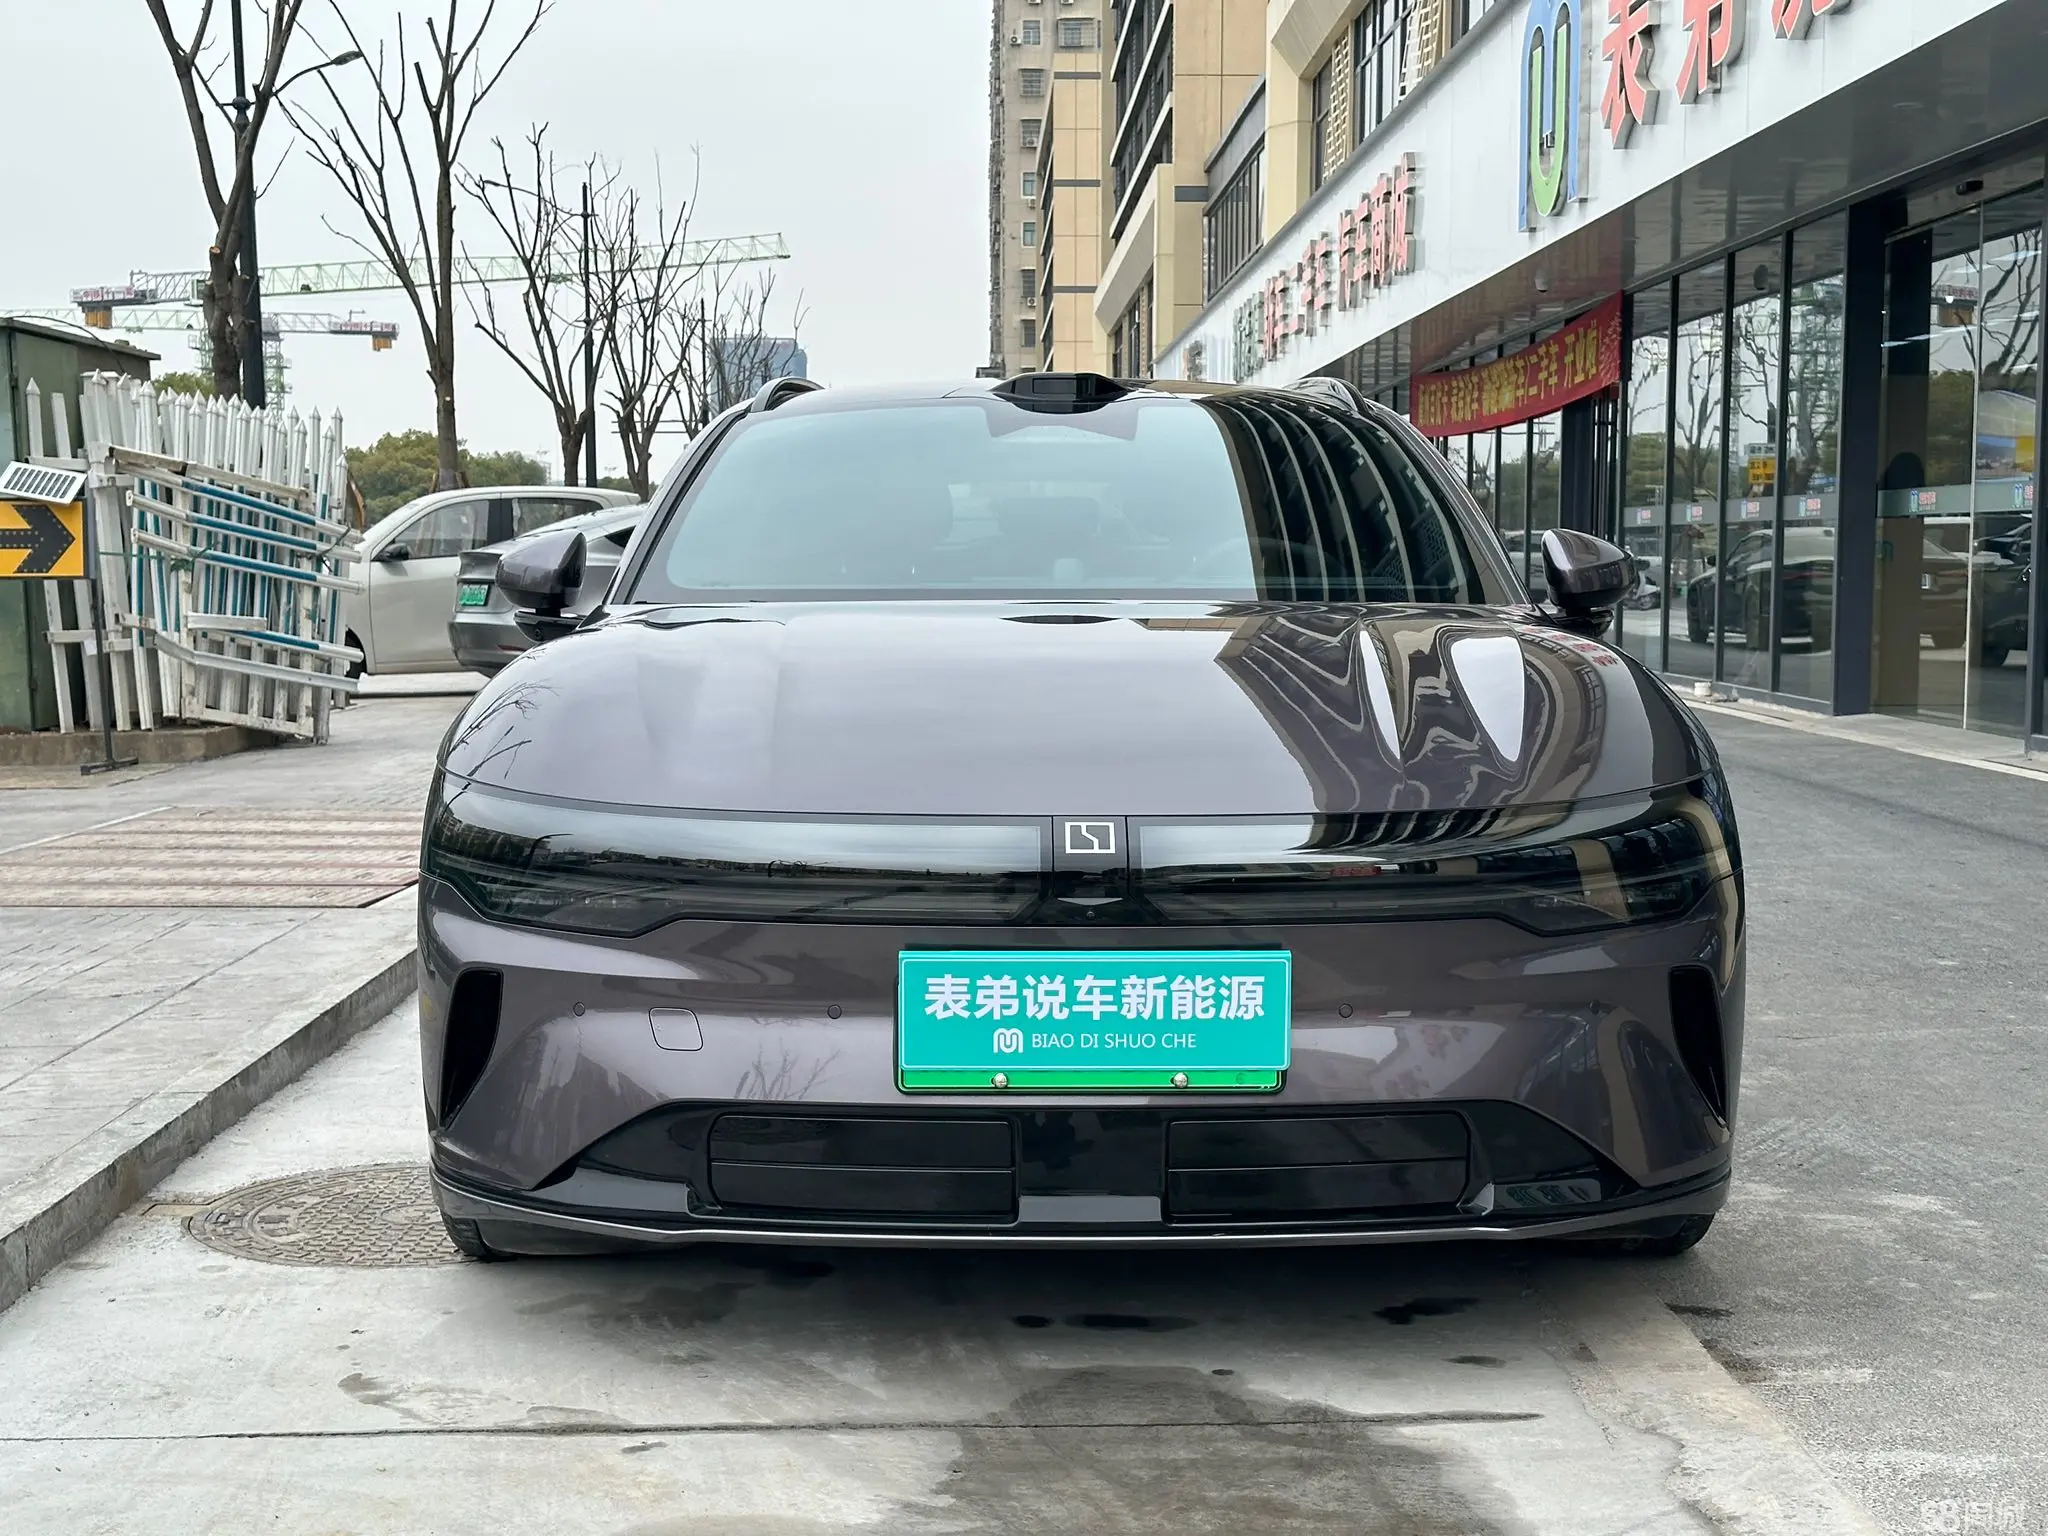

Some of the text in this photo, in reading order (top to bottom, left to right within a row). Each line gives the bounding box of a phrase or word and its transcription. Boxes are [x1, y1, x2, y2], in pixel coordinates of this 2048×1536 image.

[924, 973, 1265, 1021] 表弟说车新能源
[1031, 1033, 1197, 1049] BIAO DI SHUO CHE
